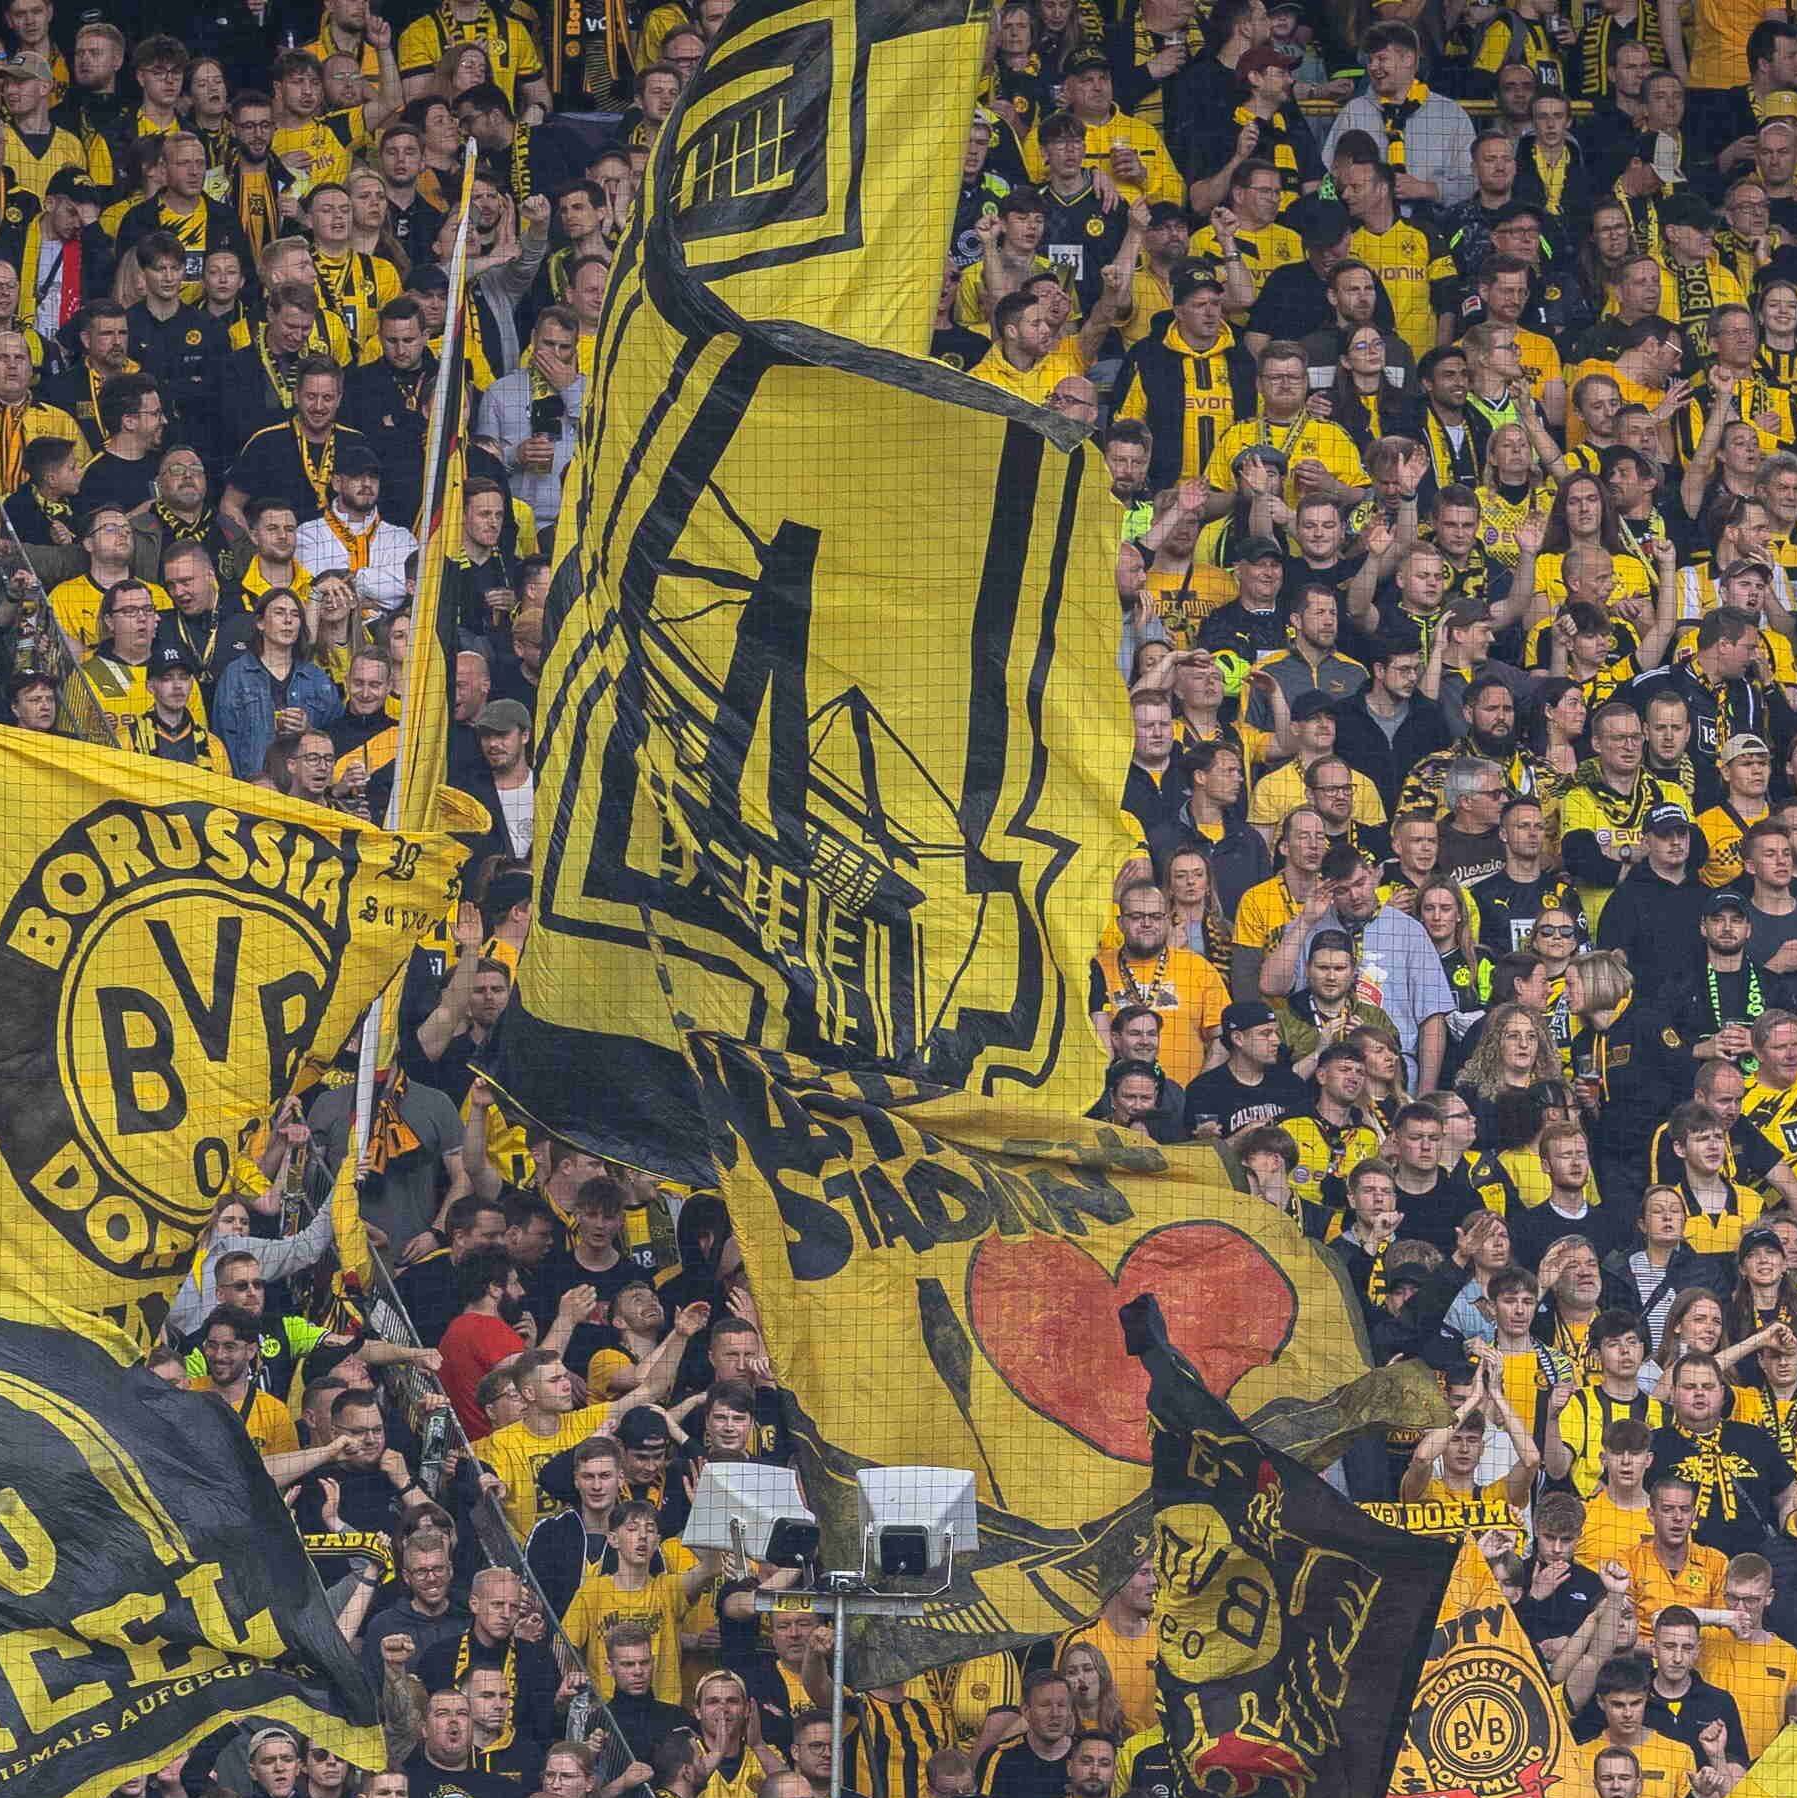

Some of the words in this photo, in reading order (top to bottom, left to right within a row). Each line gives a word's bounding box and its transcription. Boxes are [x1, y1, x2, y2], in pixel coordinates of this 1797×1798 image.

[8, 808, 344, 971] BORUSSIA
[1424, 1647, 1524, 1708] BORUSSIA
[1452, 1699, 1506, 1751] BVB
